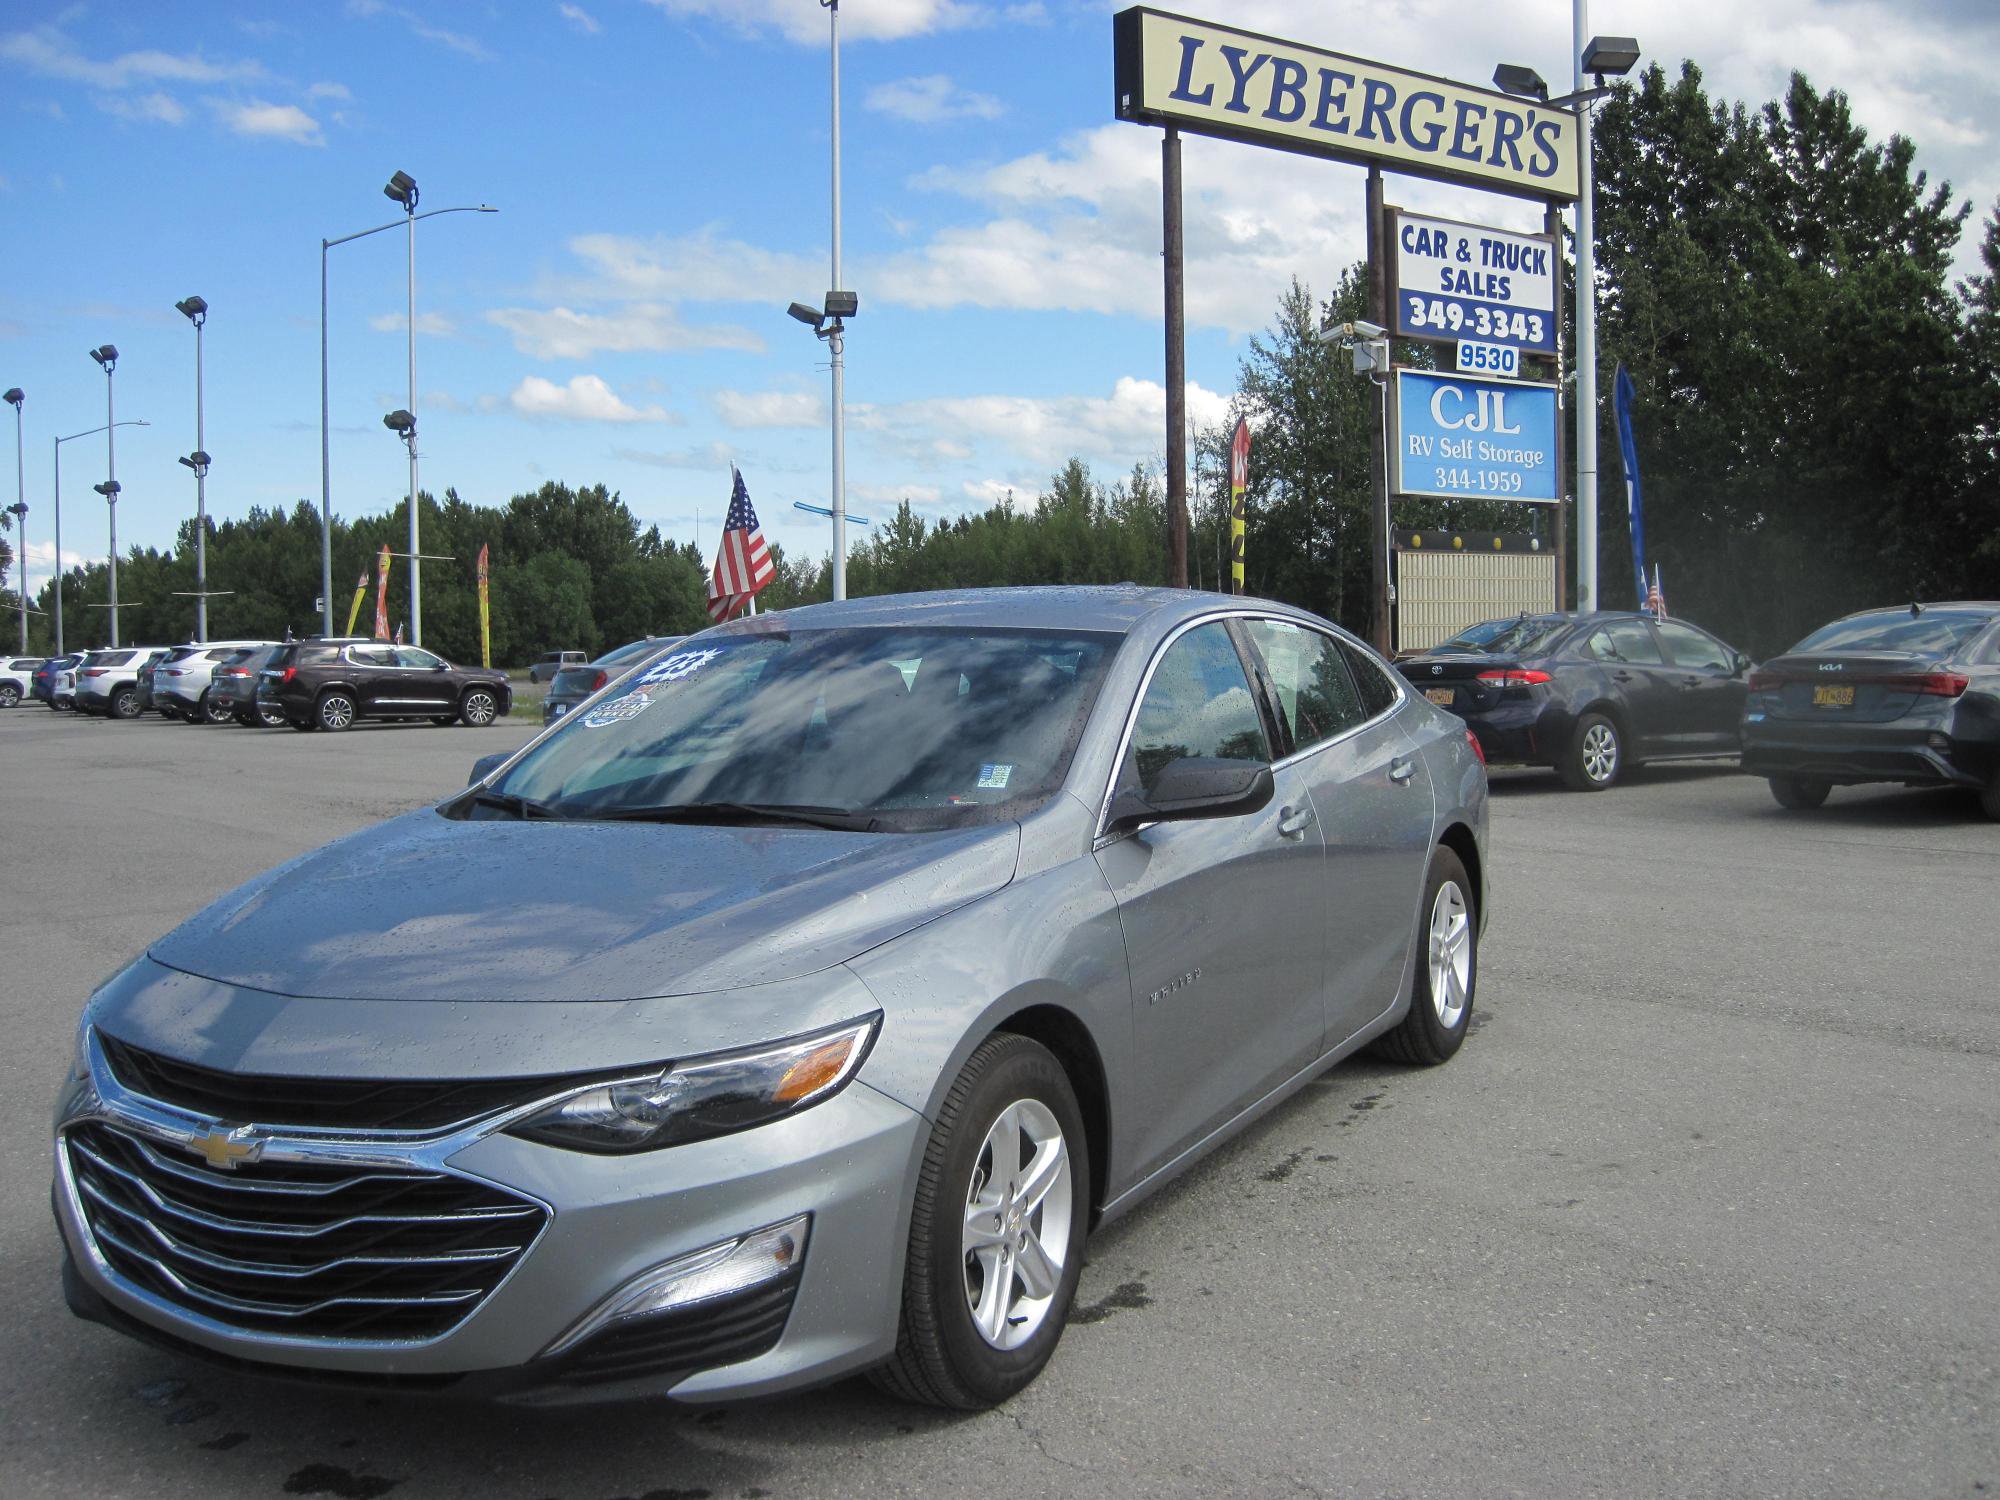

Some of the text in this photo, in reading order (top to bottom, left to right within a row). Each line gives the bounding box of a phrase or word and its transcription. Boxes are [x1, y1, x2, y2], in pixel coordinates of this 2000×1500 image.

[1169, 36, 1561, 178] LYBERGER'S
[1401, 225, 1547, 276] CAR & TRUCK
[1440, 267, 1511, 300] SALES
[1409, 297, 1543, 343] 349-3343
[1461, 344, 1514, 372] 9530
[1431, 385, 1520, 434] CJL
[1409, 435, 1544, 468] RV Self Storage
[1435, 467, 1522, 492] 344-1959
[1149, 967, 1201, 1007] MALIBU
